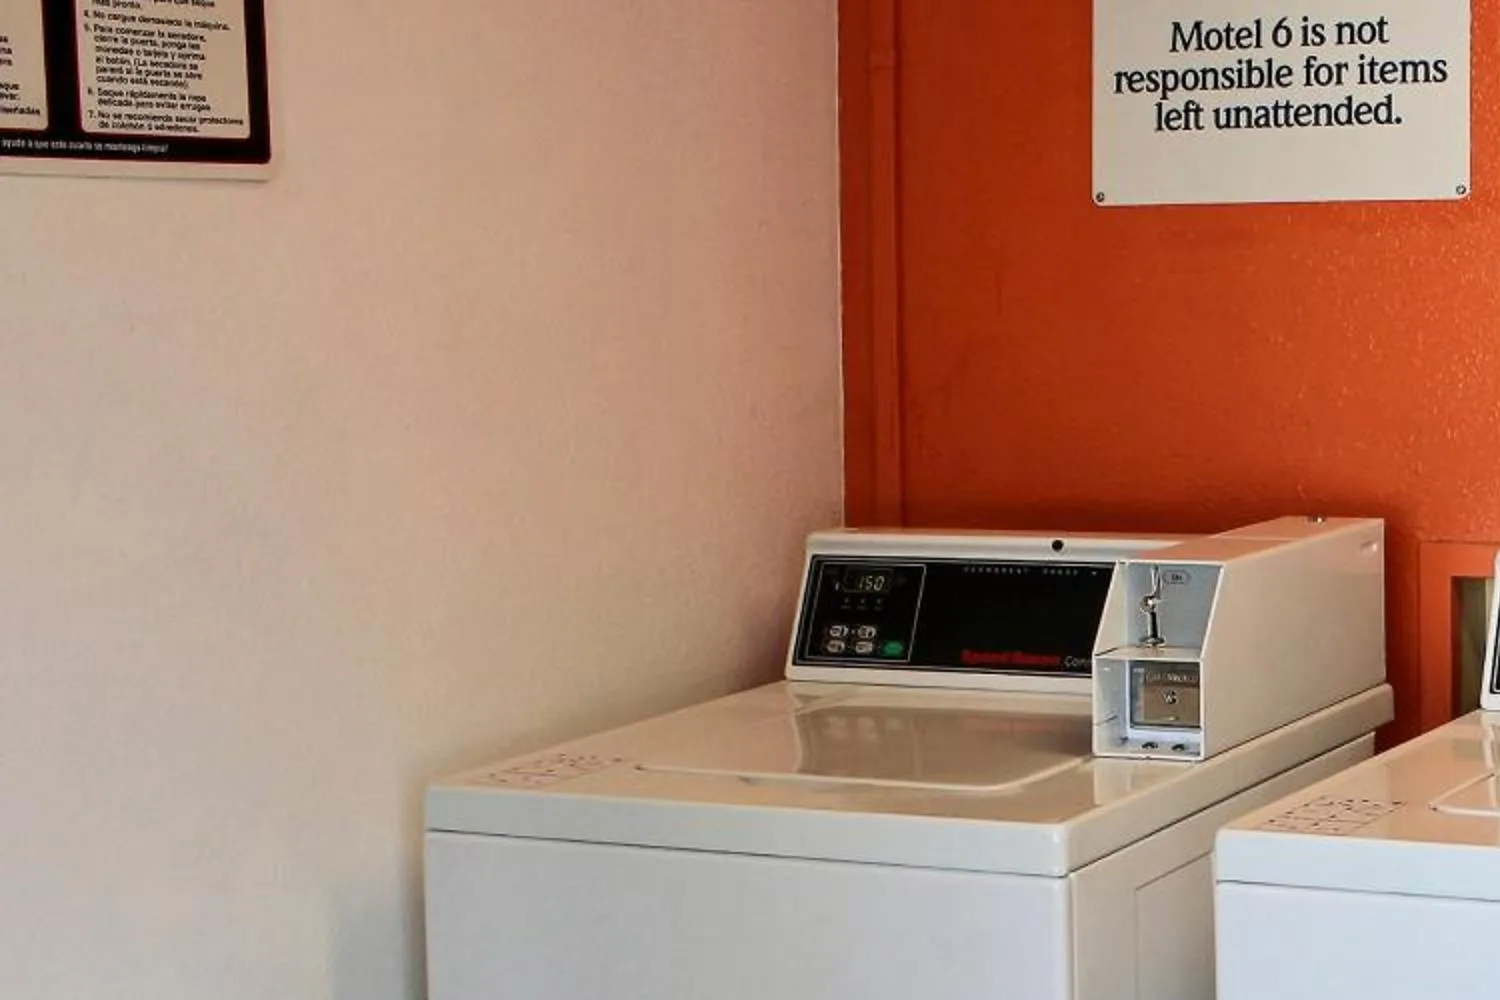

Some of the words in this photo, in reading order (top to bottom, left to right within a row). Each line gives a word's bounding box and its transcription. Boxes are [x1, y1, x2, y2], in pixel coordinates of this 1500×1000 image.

[94, 23, 113, 32] Para
[1169, 19, 1263, 53] Motel
[1271, 16, 1293, 48] 6
[1301, 15, 1326, 47] is
[1335, 16, 1389, 45] not
[1113, 58, 1293, 100] responsible
[1303, 55, 1349, 87] for
[1357, 54, 1448, 85] items
[1153, 100, 1205, 131] left
[1212, 94, 1403, 130] unattended.
